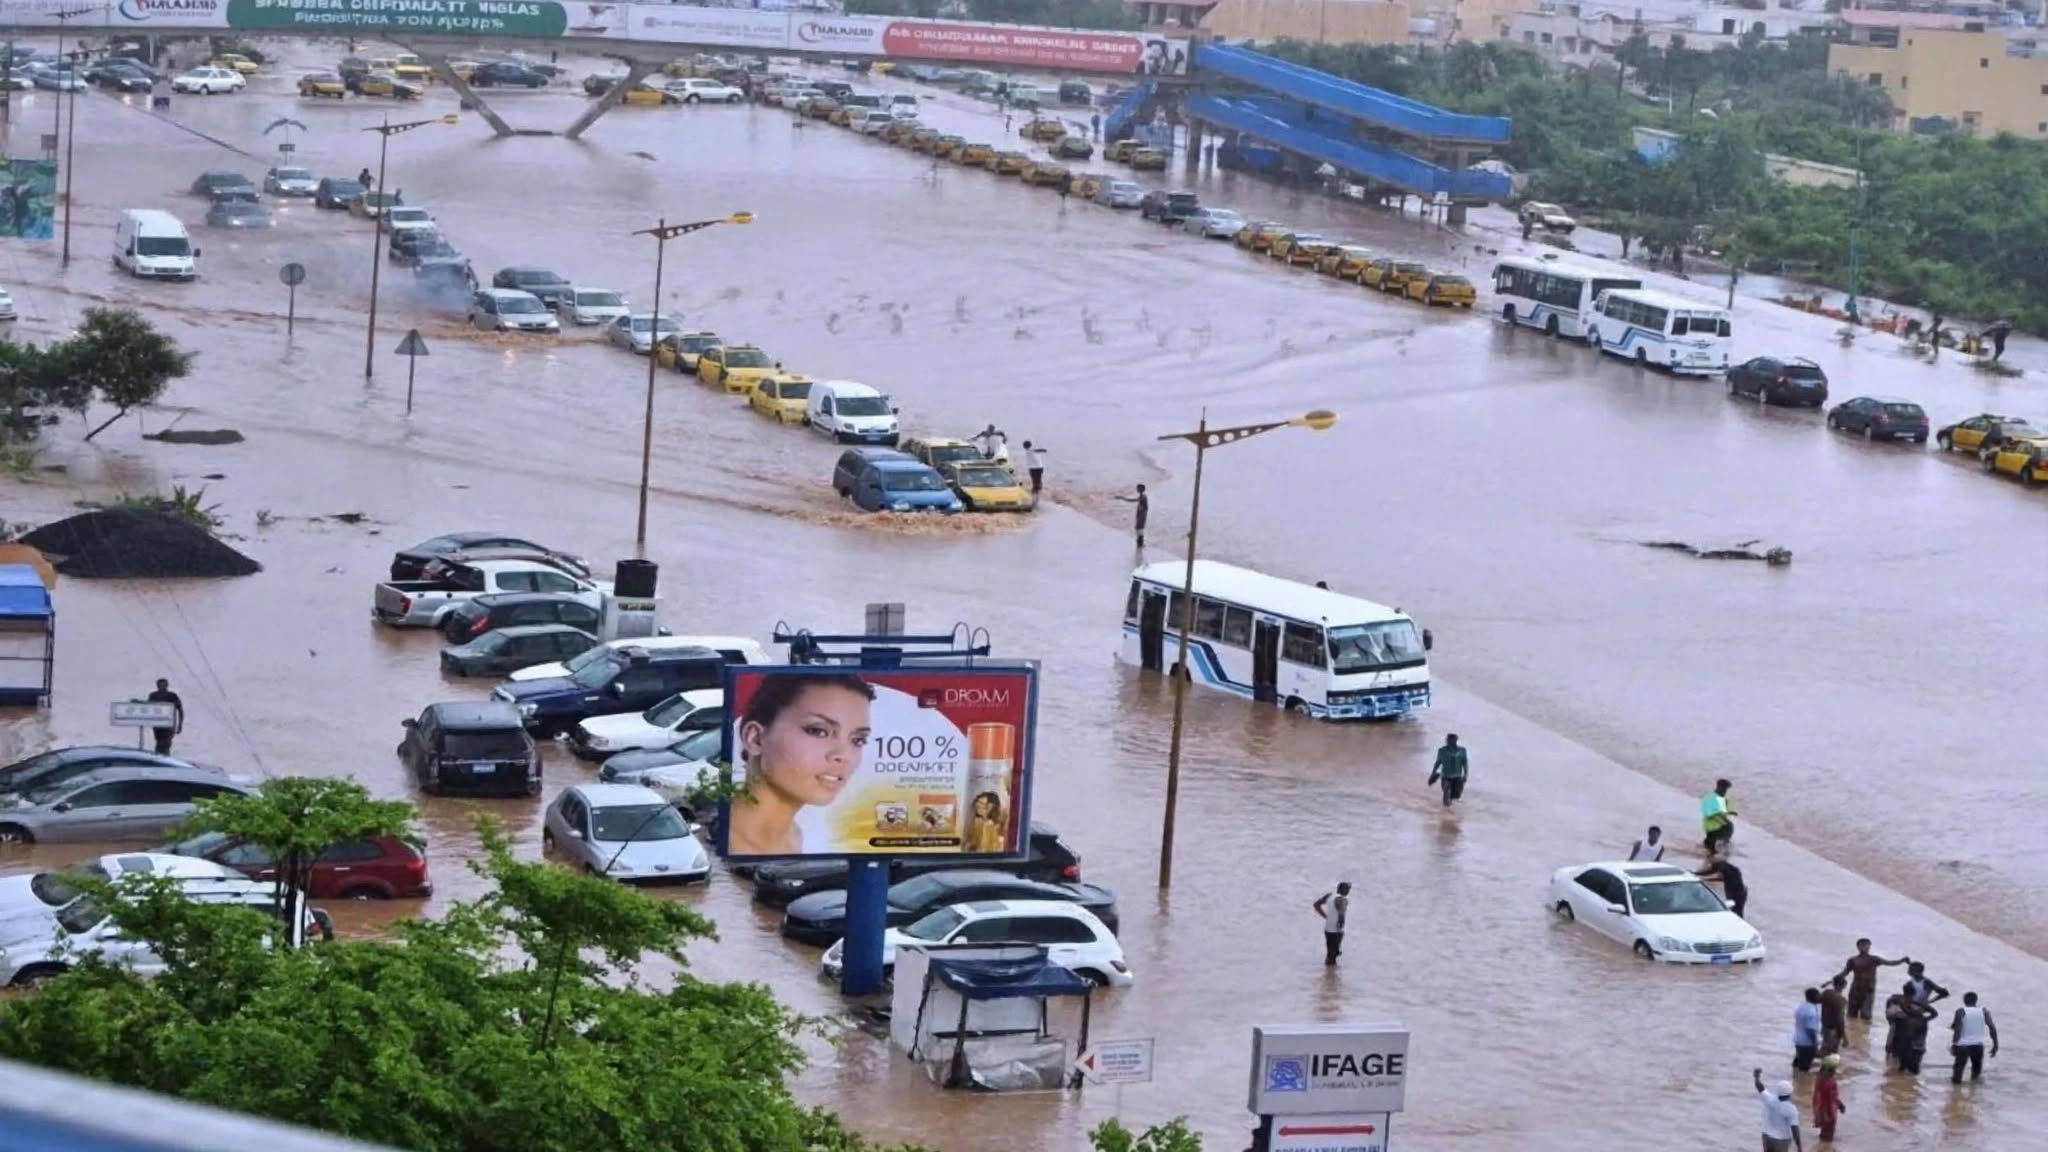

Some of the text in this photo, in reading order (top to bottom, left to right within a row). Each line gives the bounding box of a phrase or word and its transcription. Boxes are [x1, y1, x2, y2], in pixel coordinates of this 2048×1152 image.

[874, 735, 958, 759] 100 %
[1311, 1053, 1405, 1077] IFAGE
